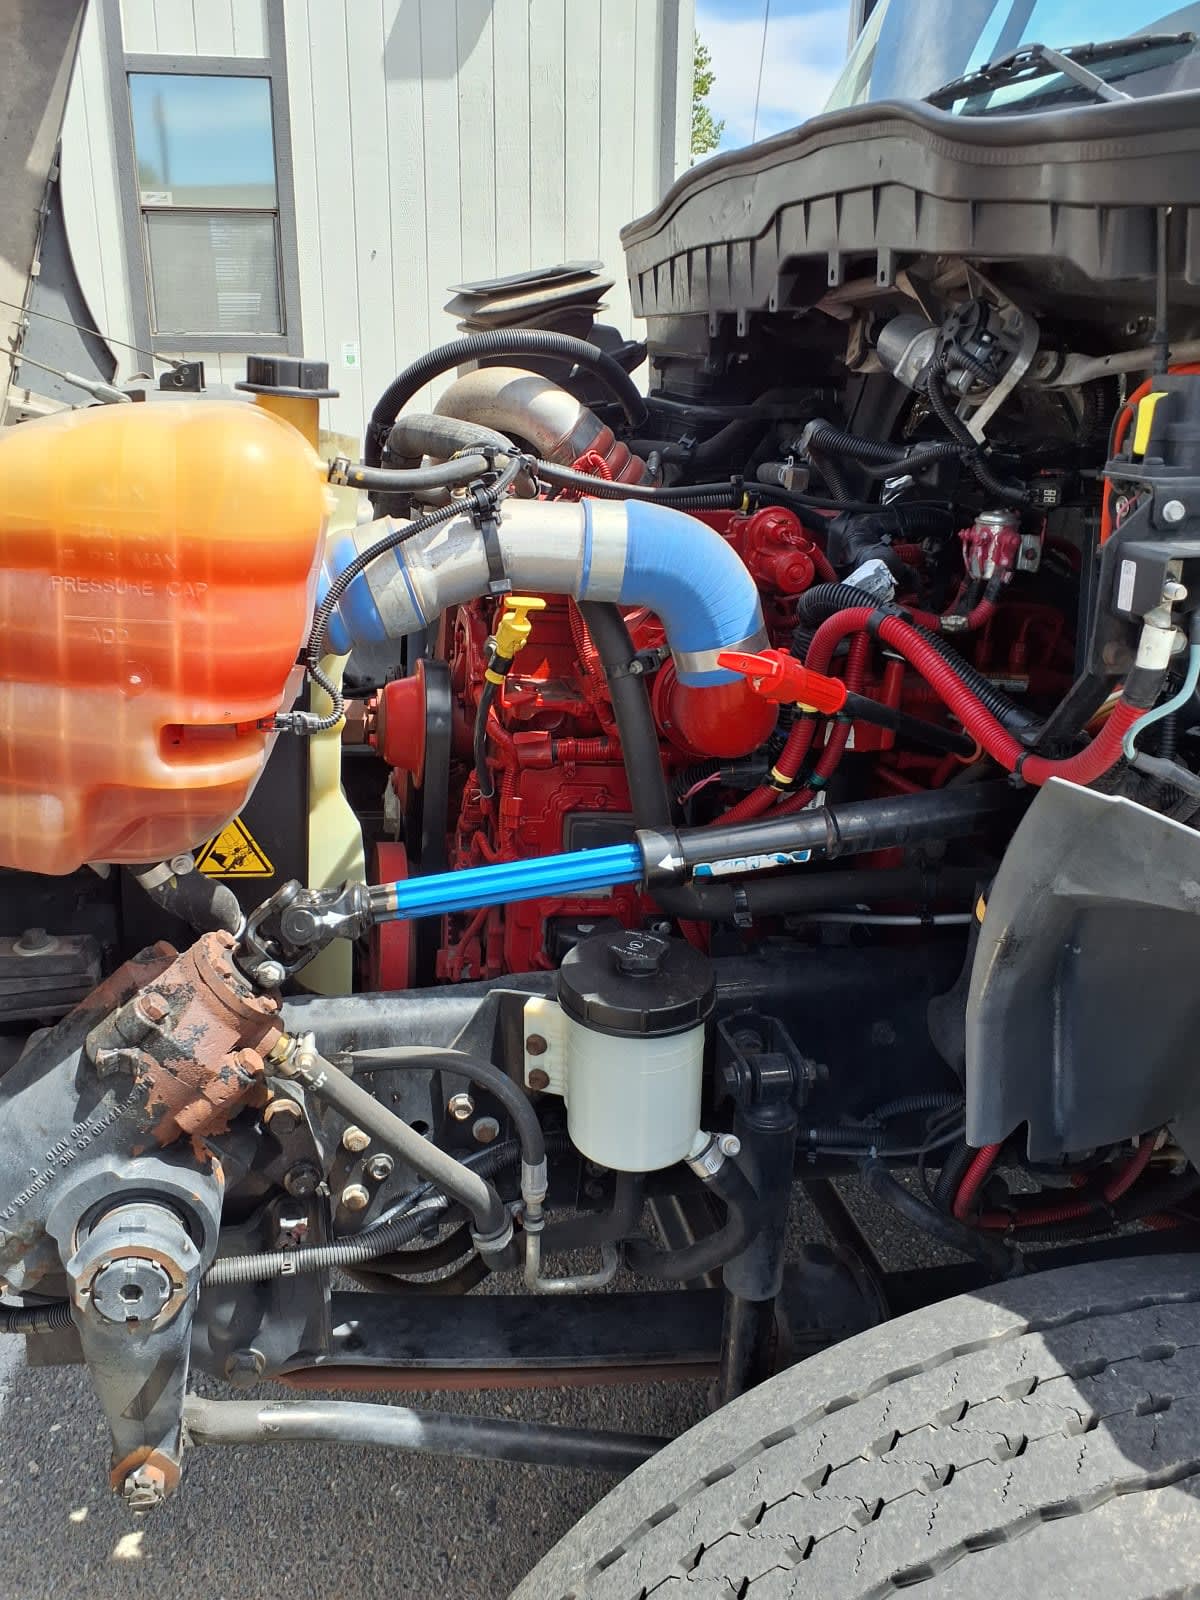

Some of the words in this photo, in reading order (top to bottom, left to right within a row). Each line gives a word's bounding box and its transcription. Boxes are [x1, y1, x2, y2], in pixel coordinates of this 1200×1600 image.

[50, 575, 153, 597] PRESSURE
[166, 582, 209, 601] CAP
[88, 627, 129, 645] ADD
[308, 1071, 328, 1092] OUT
[44, 1137, 71, 1162] AUTO
